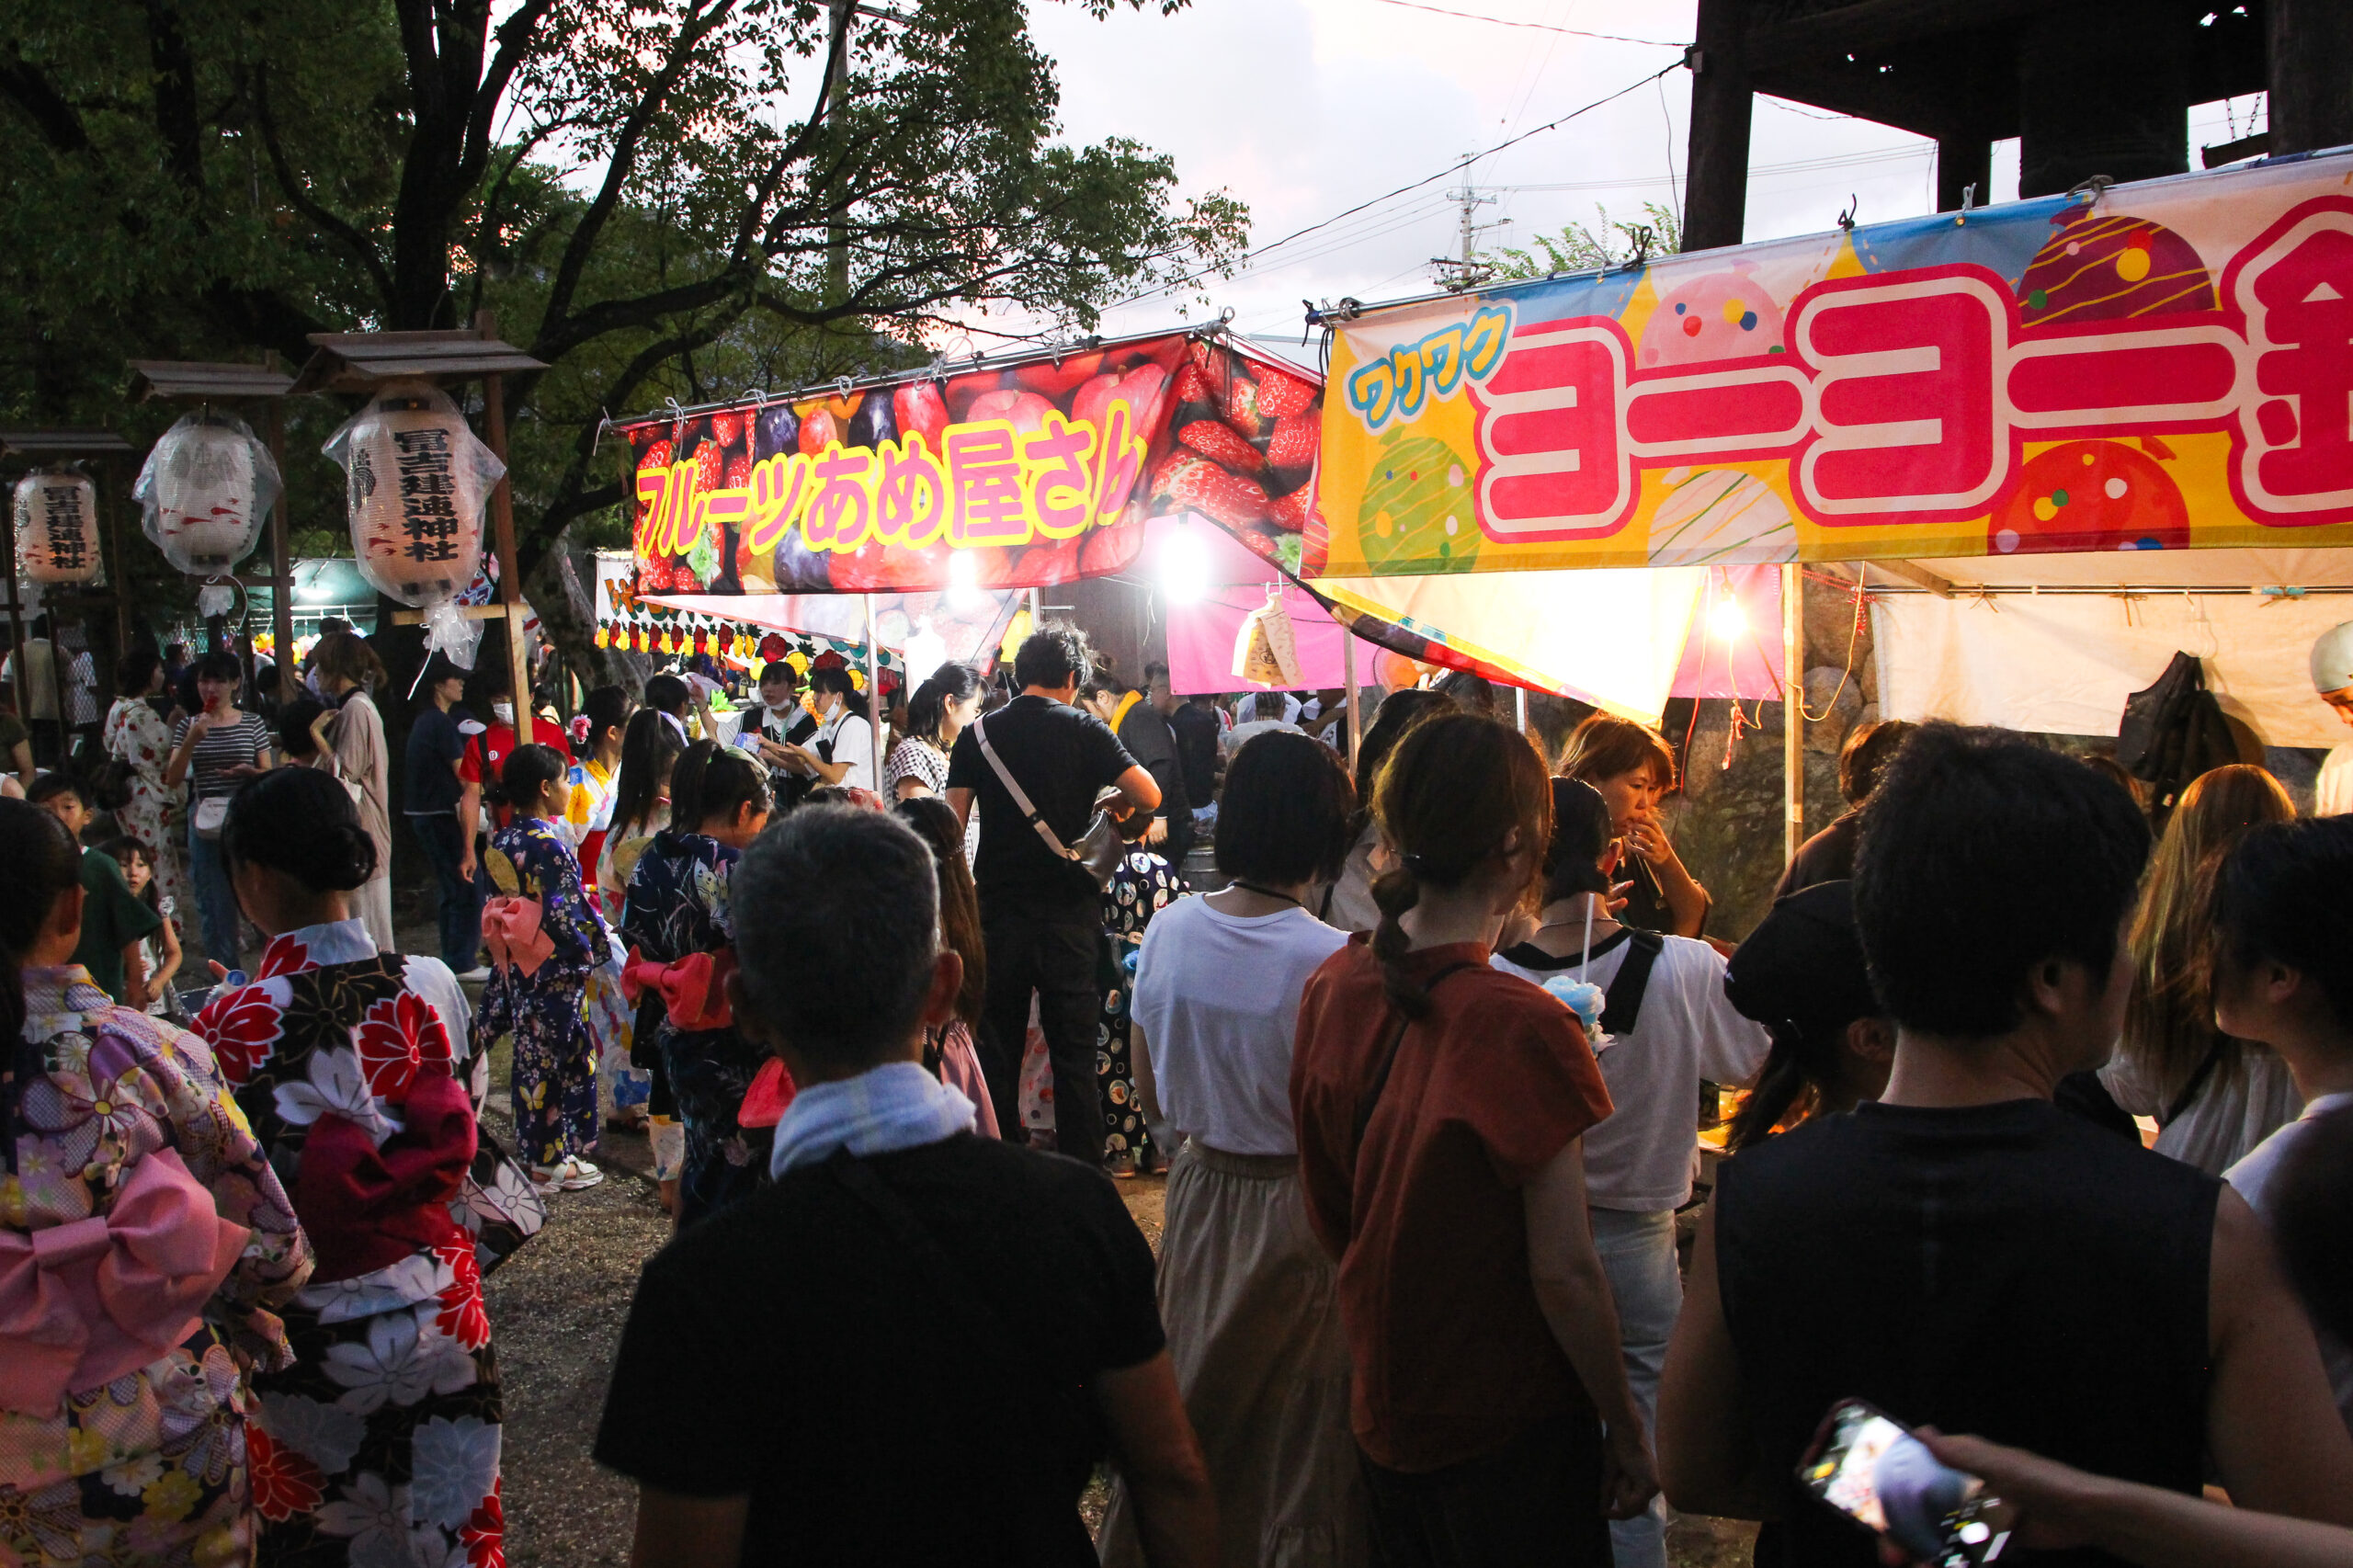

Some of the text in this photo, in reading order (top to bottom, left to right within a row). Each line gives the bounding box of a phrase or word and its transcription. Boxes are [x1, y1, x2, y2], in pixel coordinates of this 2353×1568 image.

[1348, 306, 1512, 429] ワクワク
[637, 399, 1148, 559] フルーツあめ屋さん
